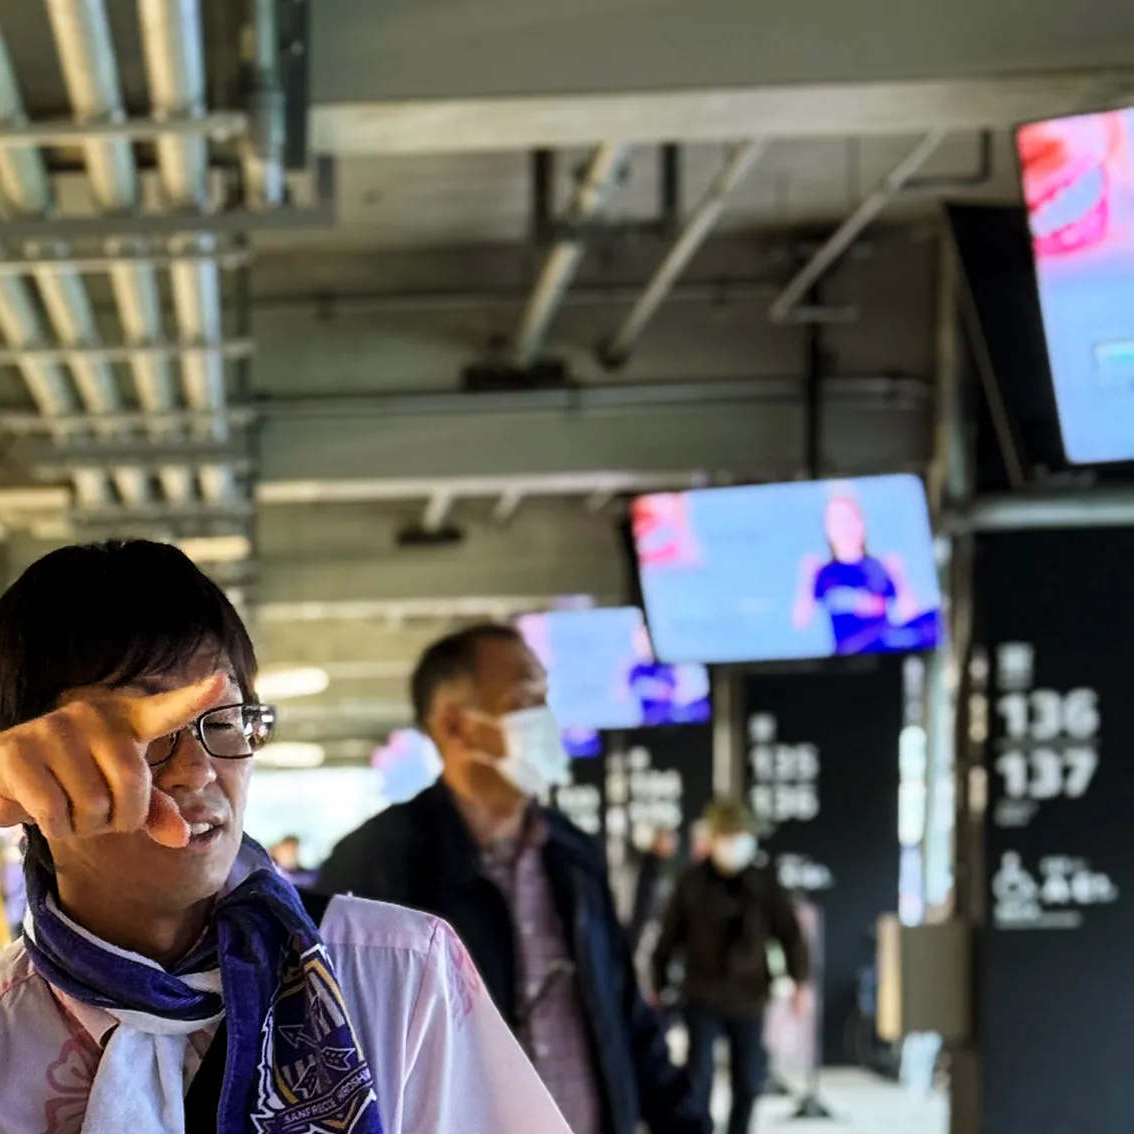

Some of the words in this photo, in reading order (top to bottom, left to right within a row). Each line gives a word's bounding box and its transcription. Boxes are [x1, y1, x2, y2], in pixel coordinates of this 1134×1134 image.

[996, 687, 1100, 740] 136
[995, 748, 1099, 798] 137
[283, 1098, 337, 1124] SANFRECCE
